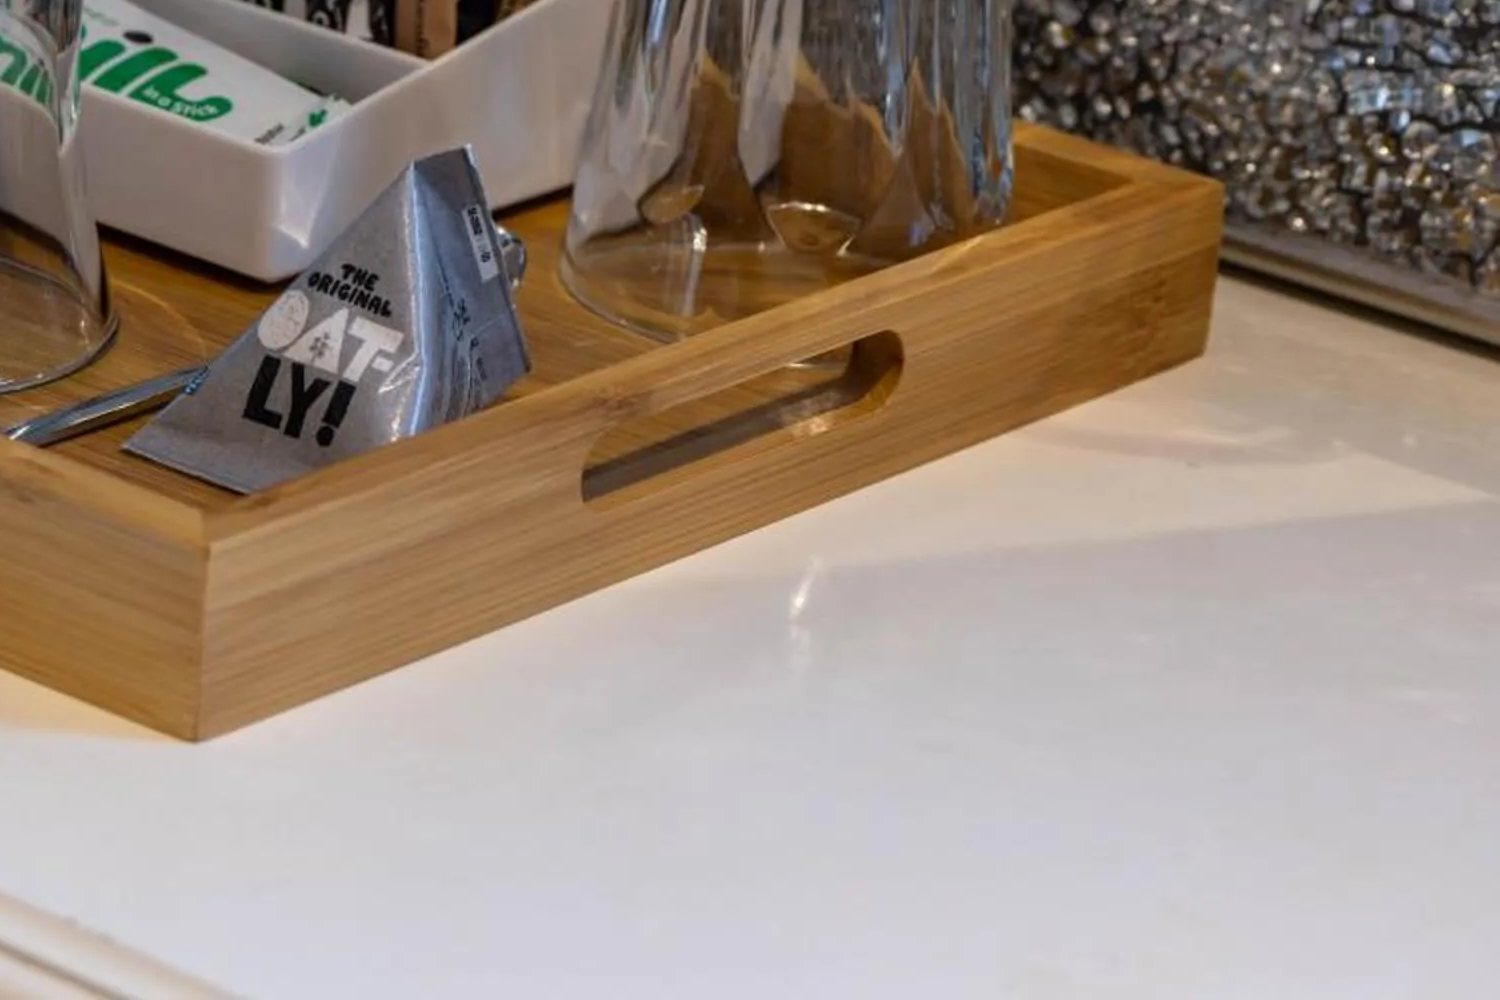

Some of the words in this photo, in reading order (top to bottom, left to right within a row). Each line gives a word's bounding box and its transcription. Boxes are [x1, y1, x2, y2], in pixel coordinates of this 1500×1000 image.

[307, 271, 392, 317] ORIGINAL
[341, 263, 379, 291] THE
[242, 354, 357, 447] LY!
